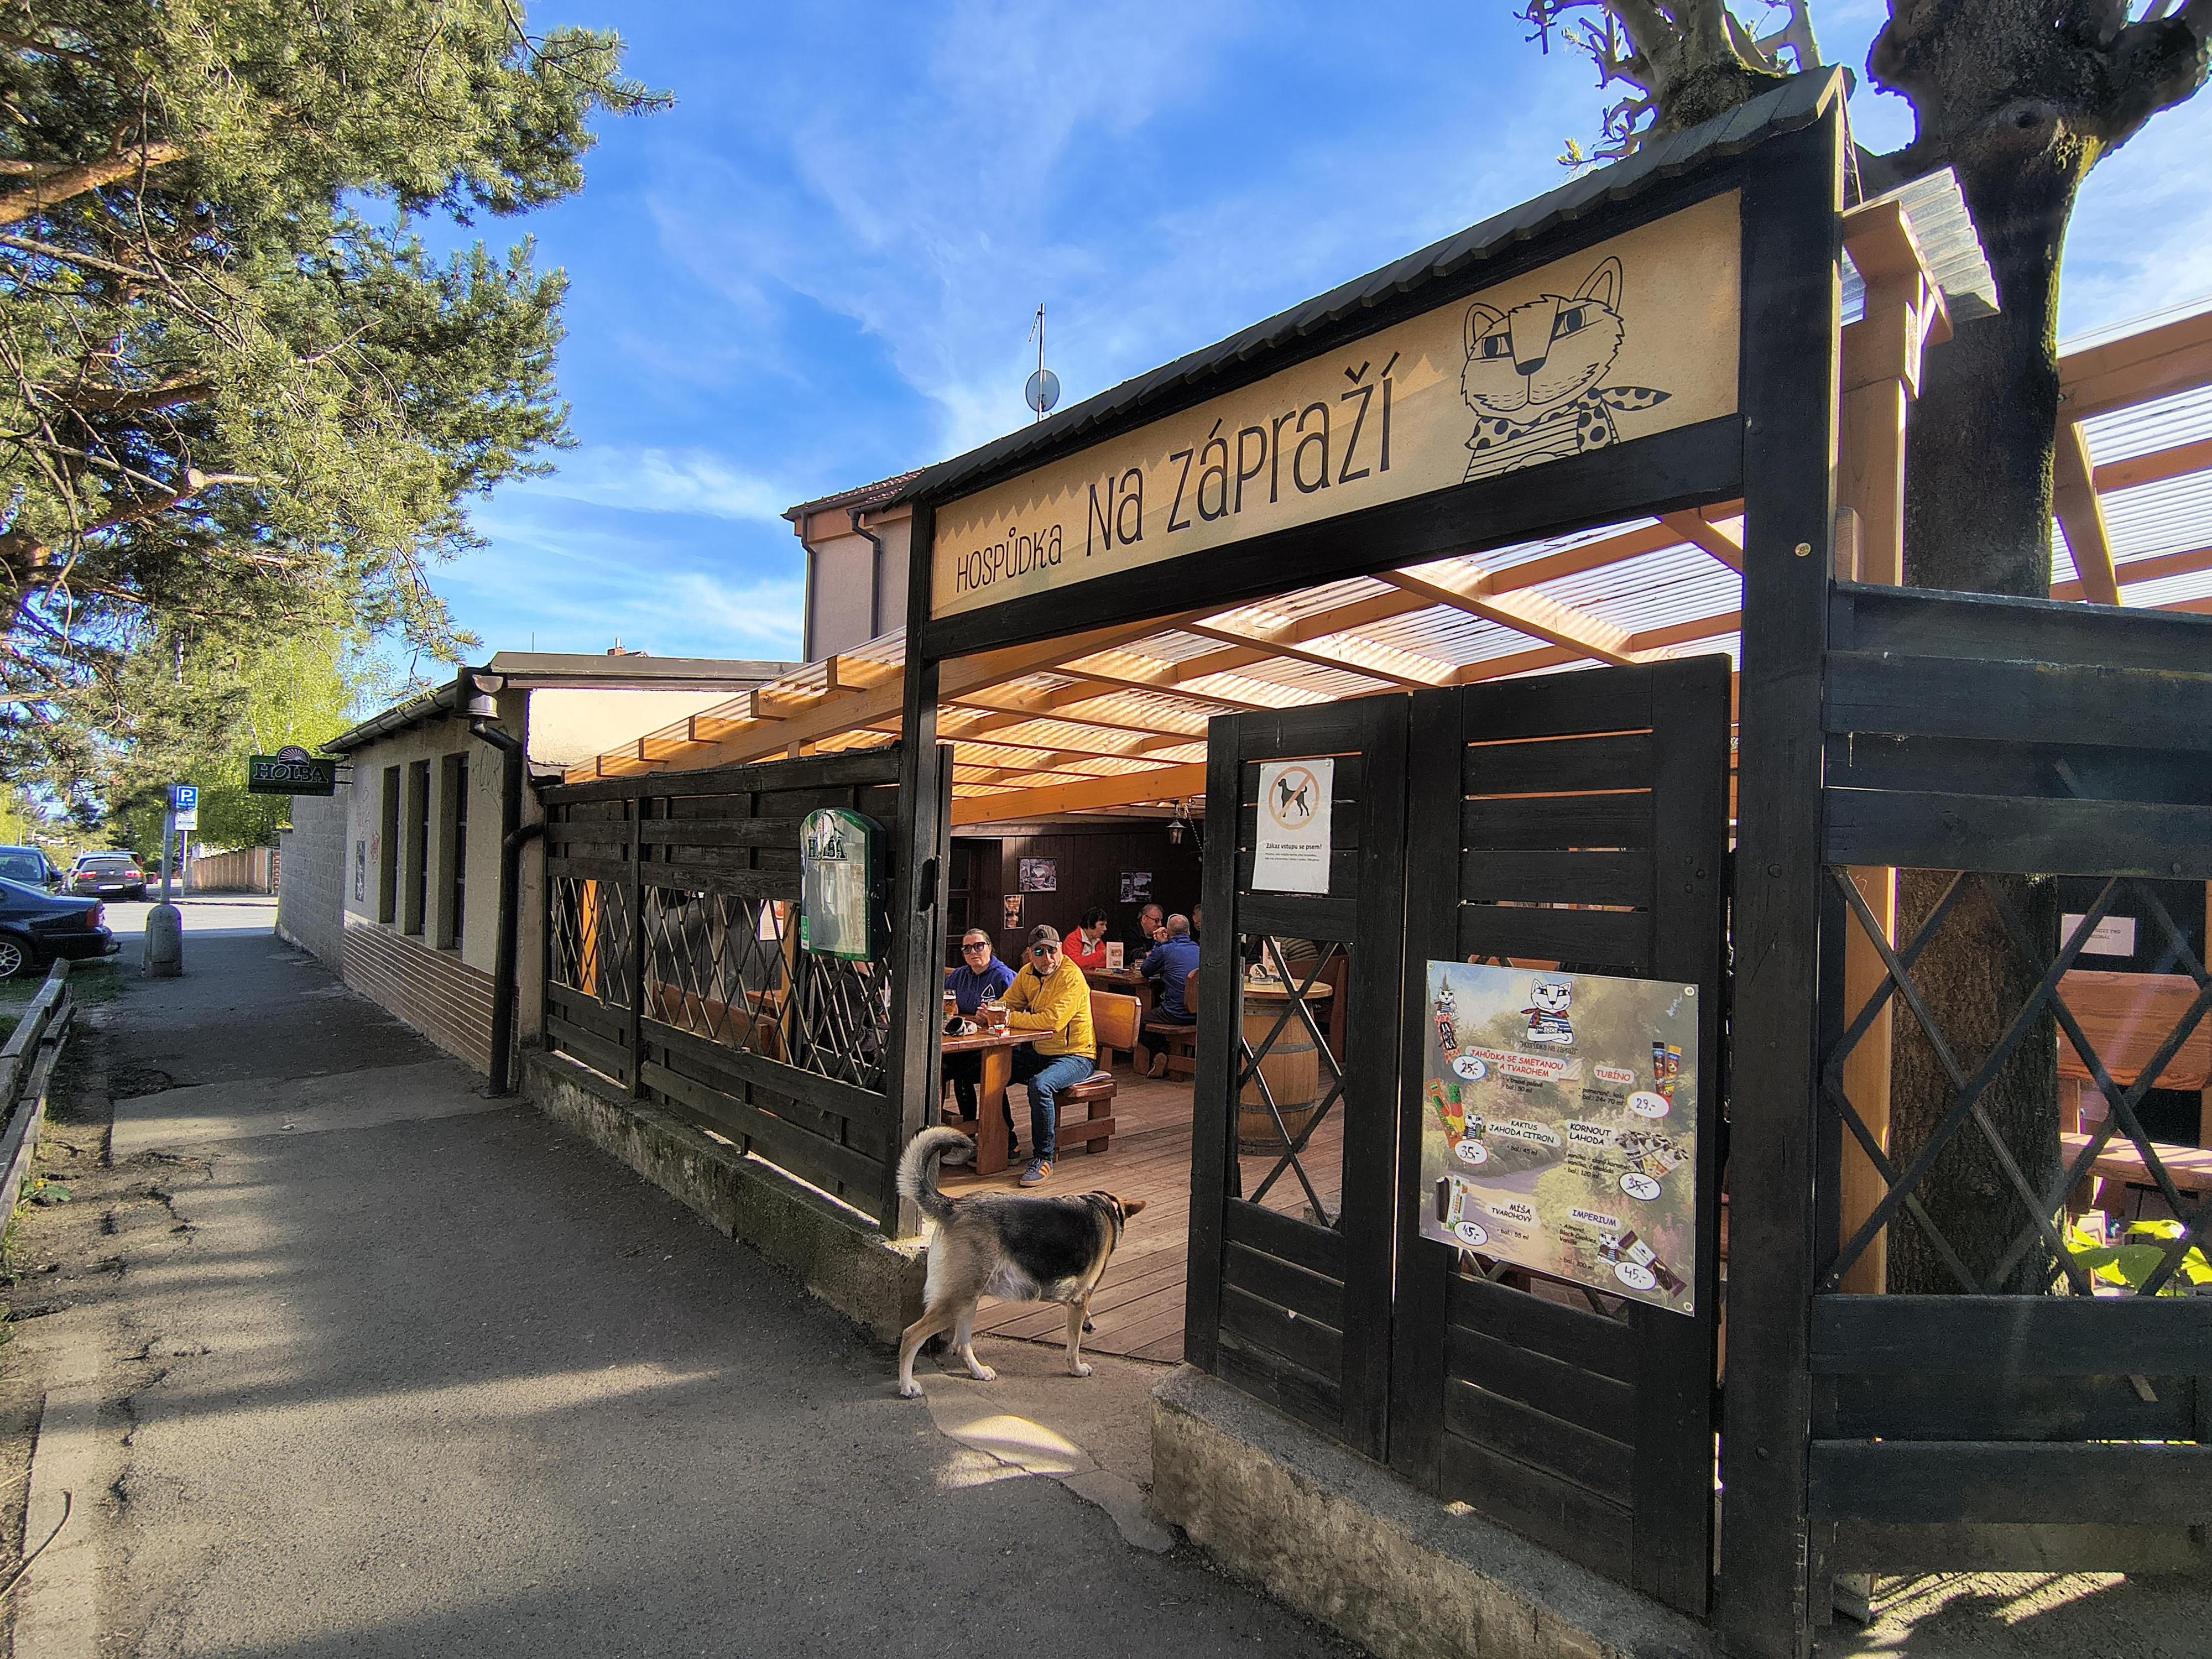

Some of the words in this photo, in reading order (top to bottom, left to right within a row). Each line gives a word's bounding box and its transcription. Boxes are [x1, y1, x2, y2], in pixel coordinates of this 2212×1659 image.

[1086, 468, 1144, 557] Na
[253, 763, 329, 783] HOLBA
[181, 789, 194, 802] P
[807, 836, 848, 860] HLBA
[1470, 1050, 1505, 1061] JAHŮDKA
[1519, 1057, 1564, 1071] SMETANOU
[1507, 1065, 1549, 1077] TVAROHEM
[1596, 1070, 1631, 1081] TUBÍNO
[1511, 1120, 1538, 1130] KAKTUS
[1570, 1123, 1611, 1136] KORNOUT
[1489, 1125, 1521, 1136] JAHODA
[1523, 1131, 1554, 1143] CITRON
[1569, 1133, 1604, 1145] LAHODA
[1491, 1207, 1532, 1223] TVAROHOVÝ
[1510, 1204, 1531, 1215] MÍŠA
[1572, 1209, 1616, 1227] IMPERIUM
